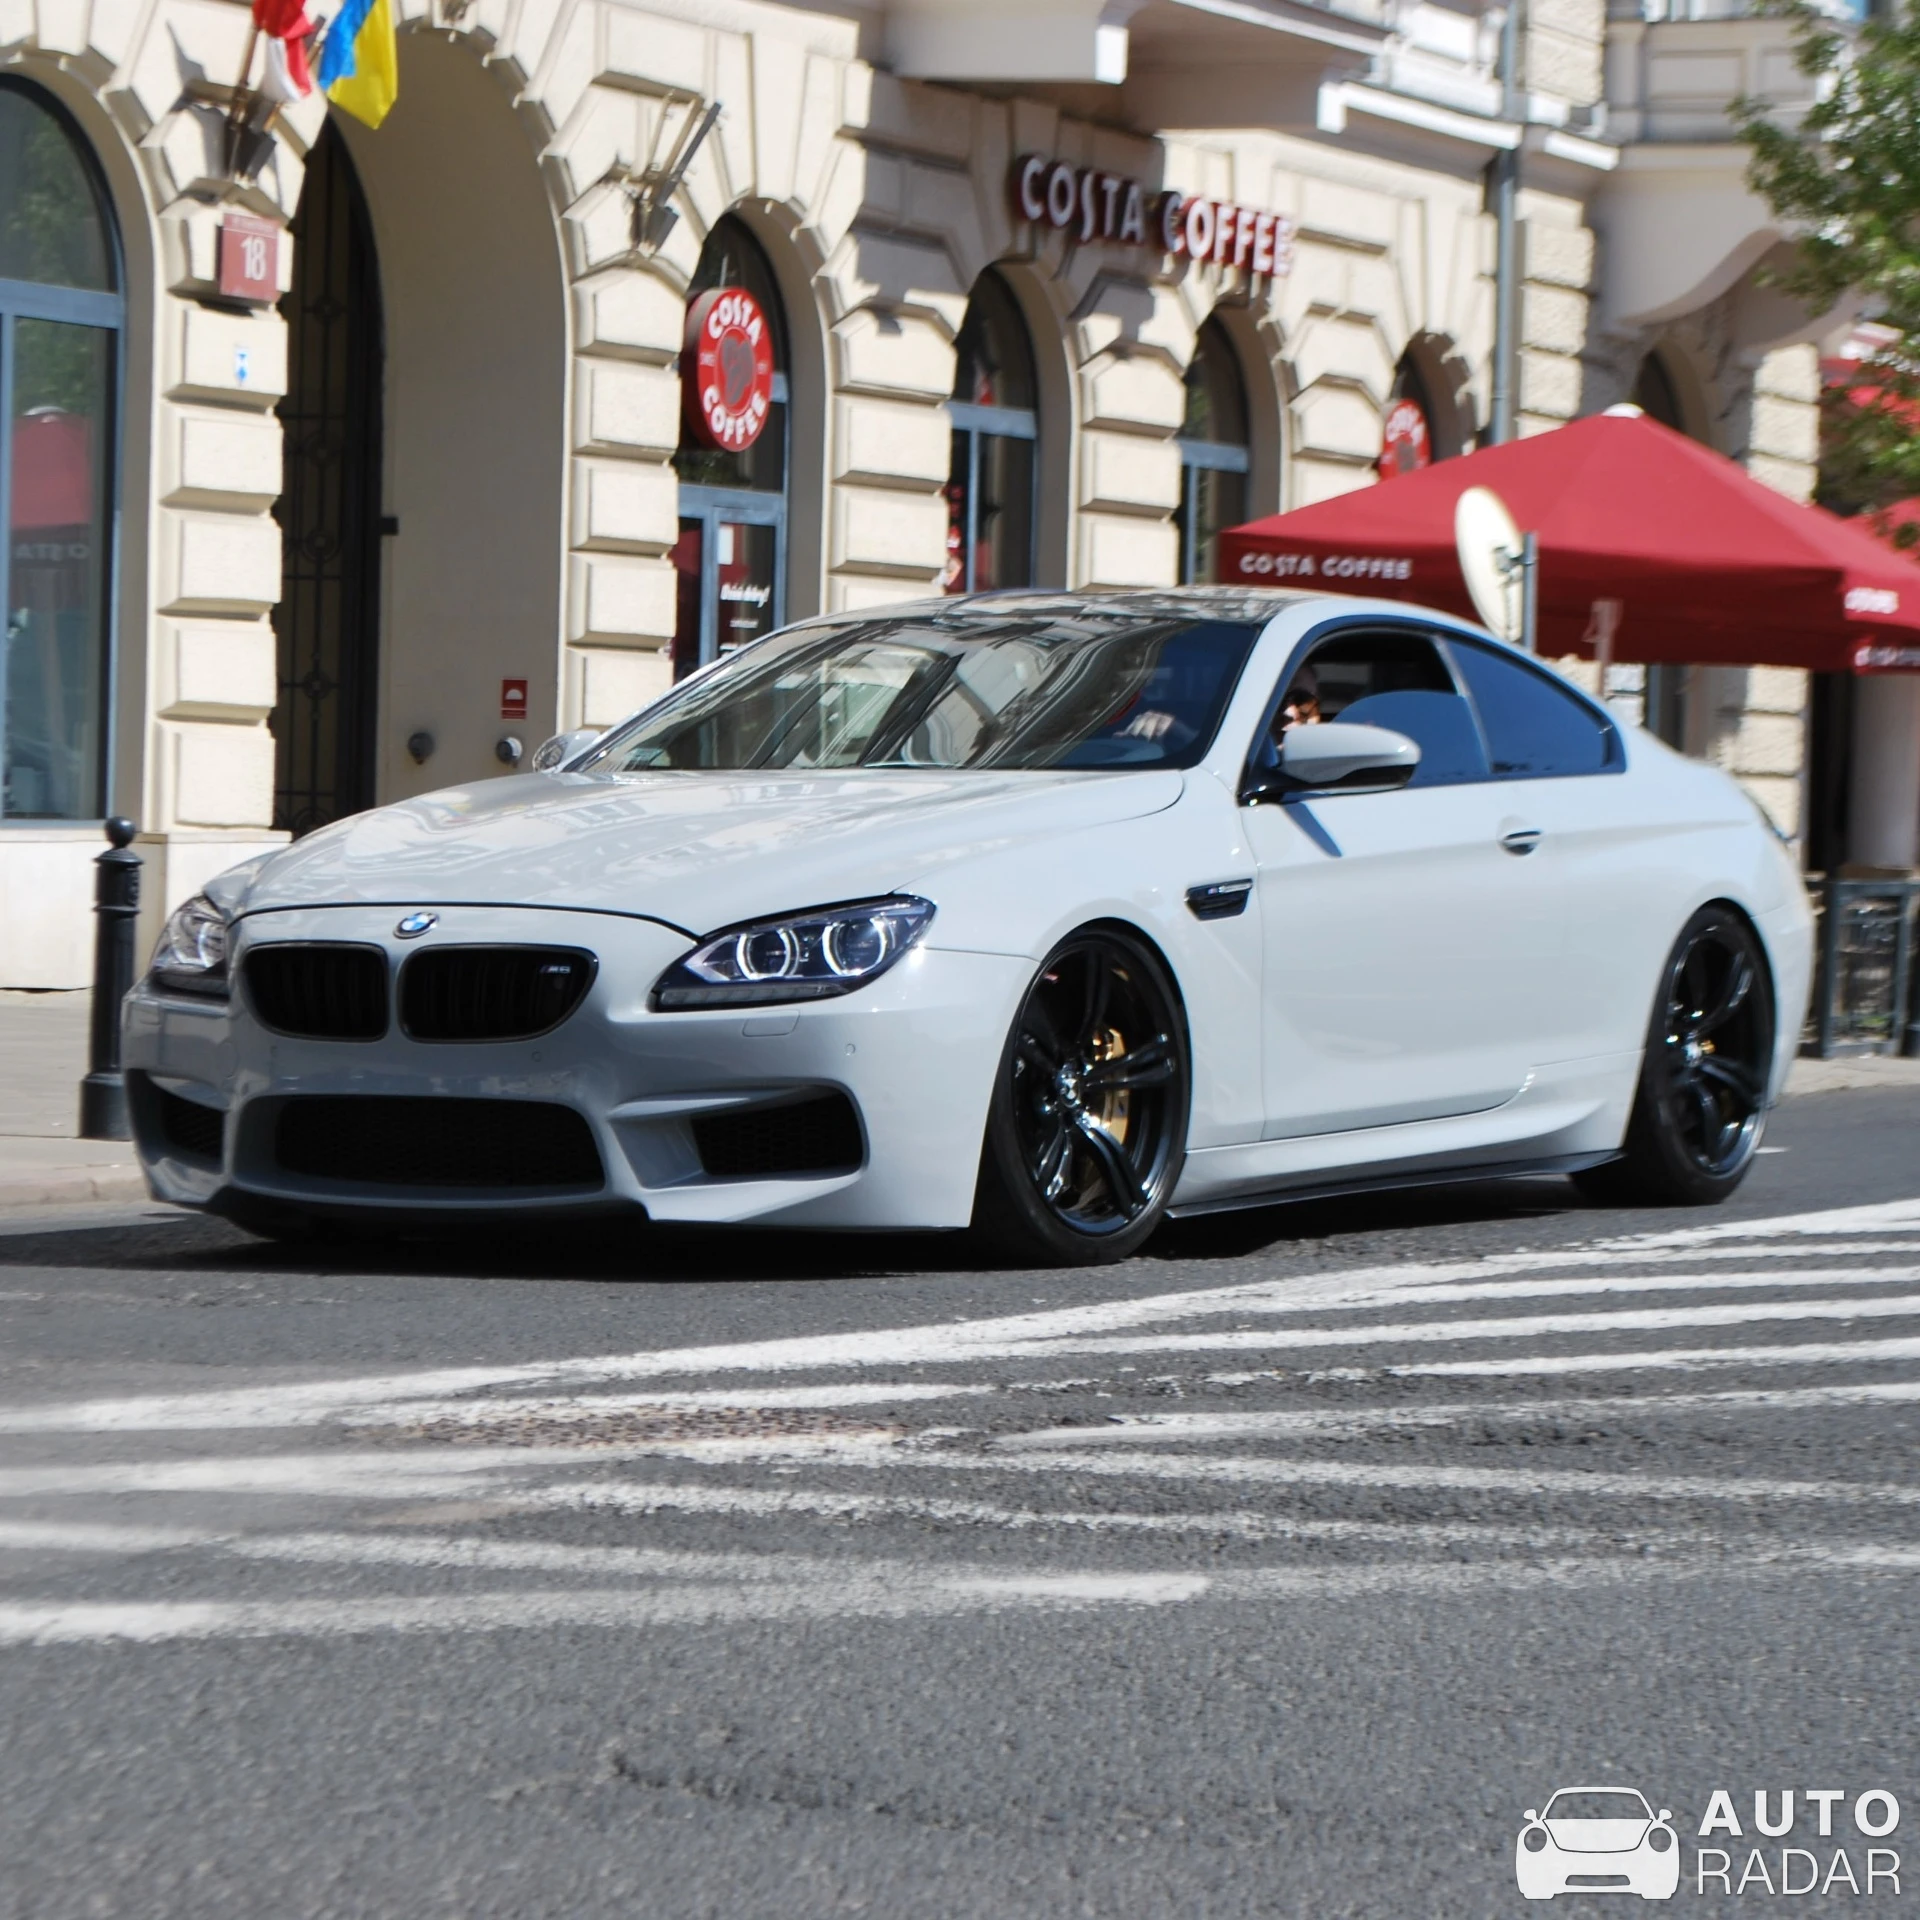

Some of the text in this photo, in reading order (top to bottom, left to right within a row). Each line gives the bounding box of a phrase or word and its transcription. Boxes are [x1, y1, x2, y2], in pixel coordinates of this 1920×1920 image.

[1020, 157, 1293, 278] COSTA COFFEE
[240, 235, 266, 281] 18
[707, 294, 763, 347] COSTA
[703, 385, 766, 445] COFFEE
[1239, 553, 1413, 580] COSTA COFFEE
